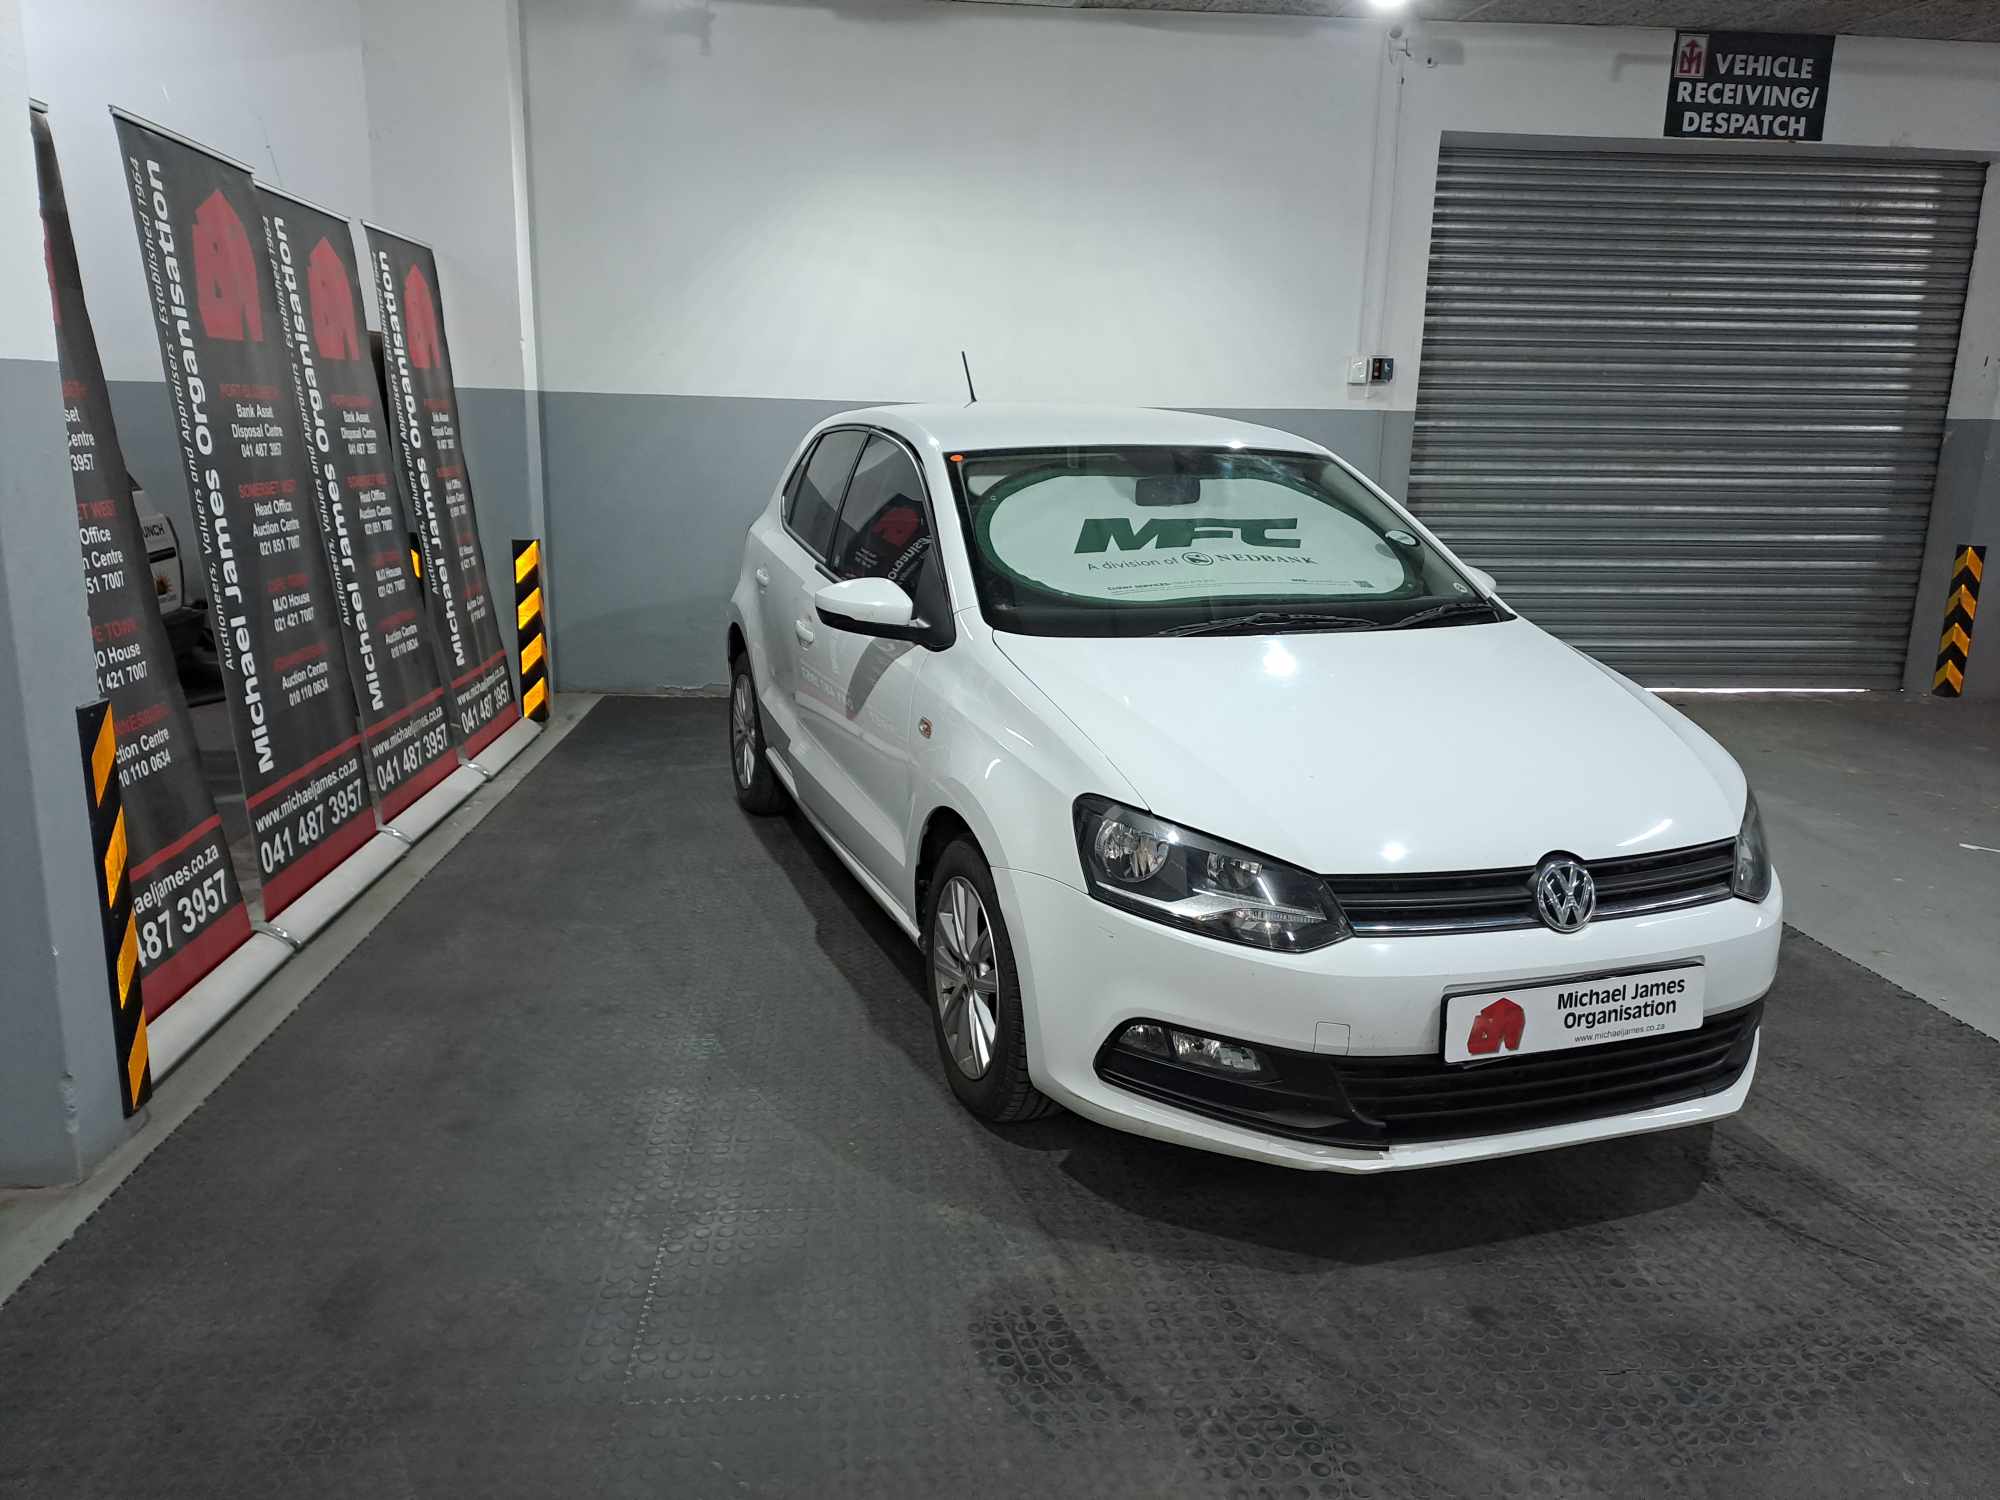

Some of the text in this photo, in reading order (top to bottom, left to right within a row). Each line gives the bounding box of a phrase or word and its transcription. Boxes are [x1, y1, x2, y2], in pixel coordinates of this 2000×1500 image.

[1715, 53, 1814, 79] VEHICLE
[1676, 81, 1819, 109] RECEIVING/
[1681, 111, 1806, 137] DESPATCH
[129, 156, 148, 206] 1964
[139, 210, 169, 325] Established
[274, 216, 330, 452] Organisation
[379, 251, 421, 449] Organisation
[166, 343, 192, 442] Appraisers
[70, 453, 94, 471] 3957
[147, 159, 275, 774] Michael James Organisation
[184, 446, 201, 482] and
[306, 446, 320, 475] and
[193, 487, 212, 554] Valuers
[314, 479, 332, 532] Valuers
[324, 463, 356, 573] James
[417, 457, 442, 550] James
[80, 526, 111, 545] Office
[1073, 517, 1302, 554] MFC
[91, 549, 124, 568] Centre
[1102, 558, 1159, 570] division
[1164, 556, 1179, 565] of
[1215, 553, 1319, 565] NEDBANK
[86, 571, 125, 594] 51 7007
[435, 557, 465, 666] Michael
[107, 643, 142, 665] House
[347, 582, 384, 711] Michael
[106, 671, 125, 690] 421
[126, 660, 148, 683] 7007
[461, 704, 480, 734] 041
[480, 693, 494, 721] 487
[140, 727, 170, 752] Centre
[376, 723, 448, 791] 041 487 3957
[130, 759, 150, 781] 110
[151, 748, 171, 772] 0634
[255, 757, 358, 833] www.michaeljames.co.za
[260, 778, 362, 873] 041 487 3957
[177, 868, 227, 933] 3957
[1557, 978, 1685, 1010] Michael James
[1563, 999, 1676, 1029] Organisation
[1574, 1022, 1665, 1043] www.michaeljames.co.za
